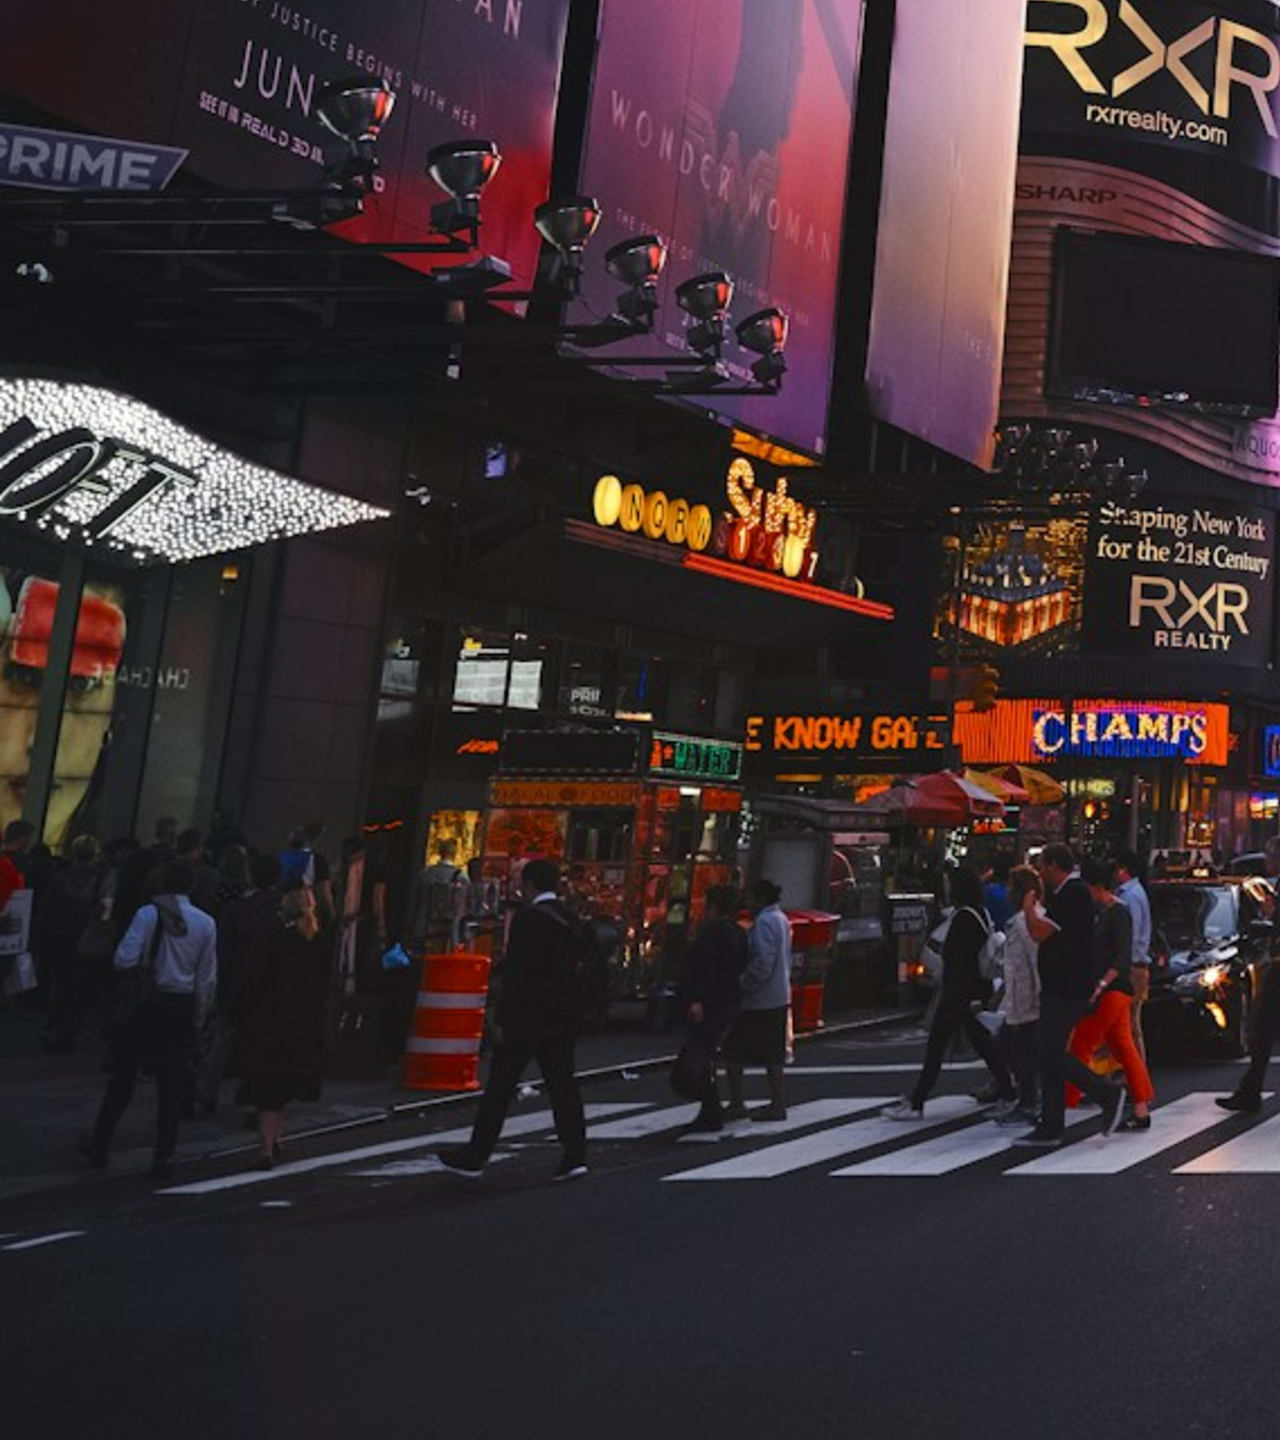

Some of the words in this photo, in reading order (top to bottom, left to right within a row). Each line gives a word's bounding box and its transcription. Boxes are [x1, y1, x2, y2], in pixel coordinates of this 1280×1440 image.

[233, 40, 317, 118] JUN
[271, 2, 338, 53] JUSTICE
[345, 42, 402, 88] BEGINS
[411, 81, 445, 112] WITH
[453, 99, 479, 130] HER
[1086, 101, 1229, 147] rxrrealty.com
[0, 133, 158, 191] RIME
[611, 89, 731, 205] WONDER
[749, 190, 833, 259] WOMAN
[1016, 183, 1117, 204] SHARP
[0, 416, 198, 541] OFT
[1192, 509, 1233, 535] New
[1235, 514, 1267, 542] York
[1097, 534, 1132, 559] for
[1136, 537, 1171, 562] the
[1174, 542, 1211, 566] 21st
[1213, 546, 1271, 580] Century
[1129, 574, 1250, 635] RXR
[1154, 629, 1232, 651] REALTY
[773, 715, 862, 750] KNOW
[1032, 709, 1208, 755] CHAMPS
